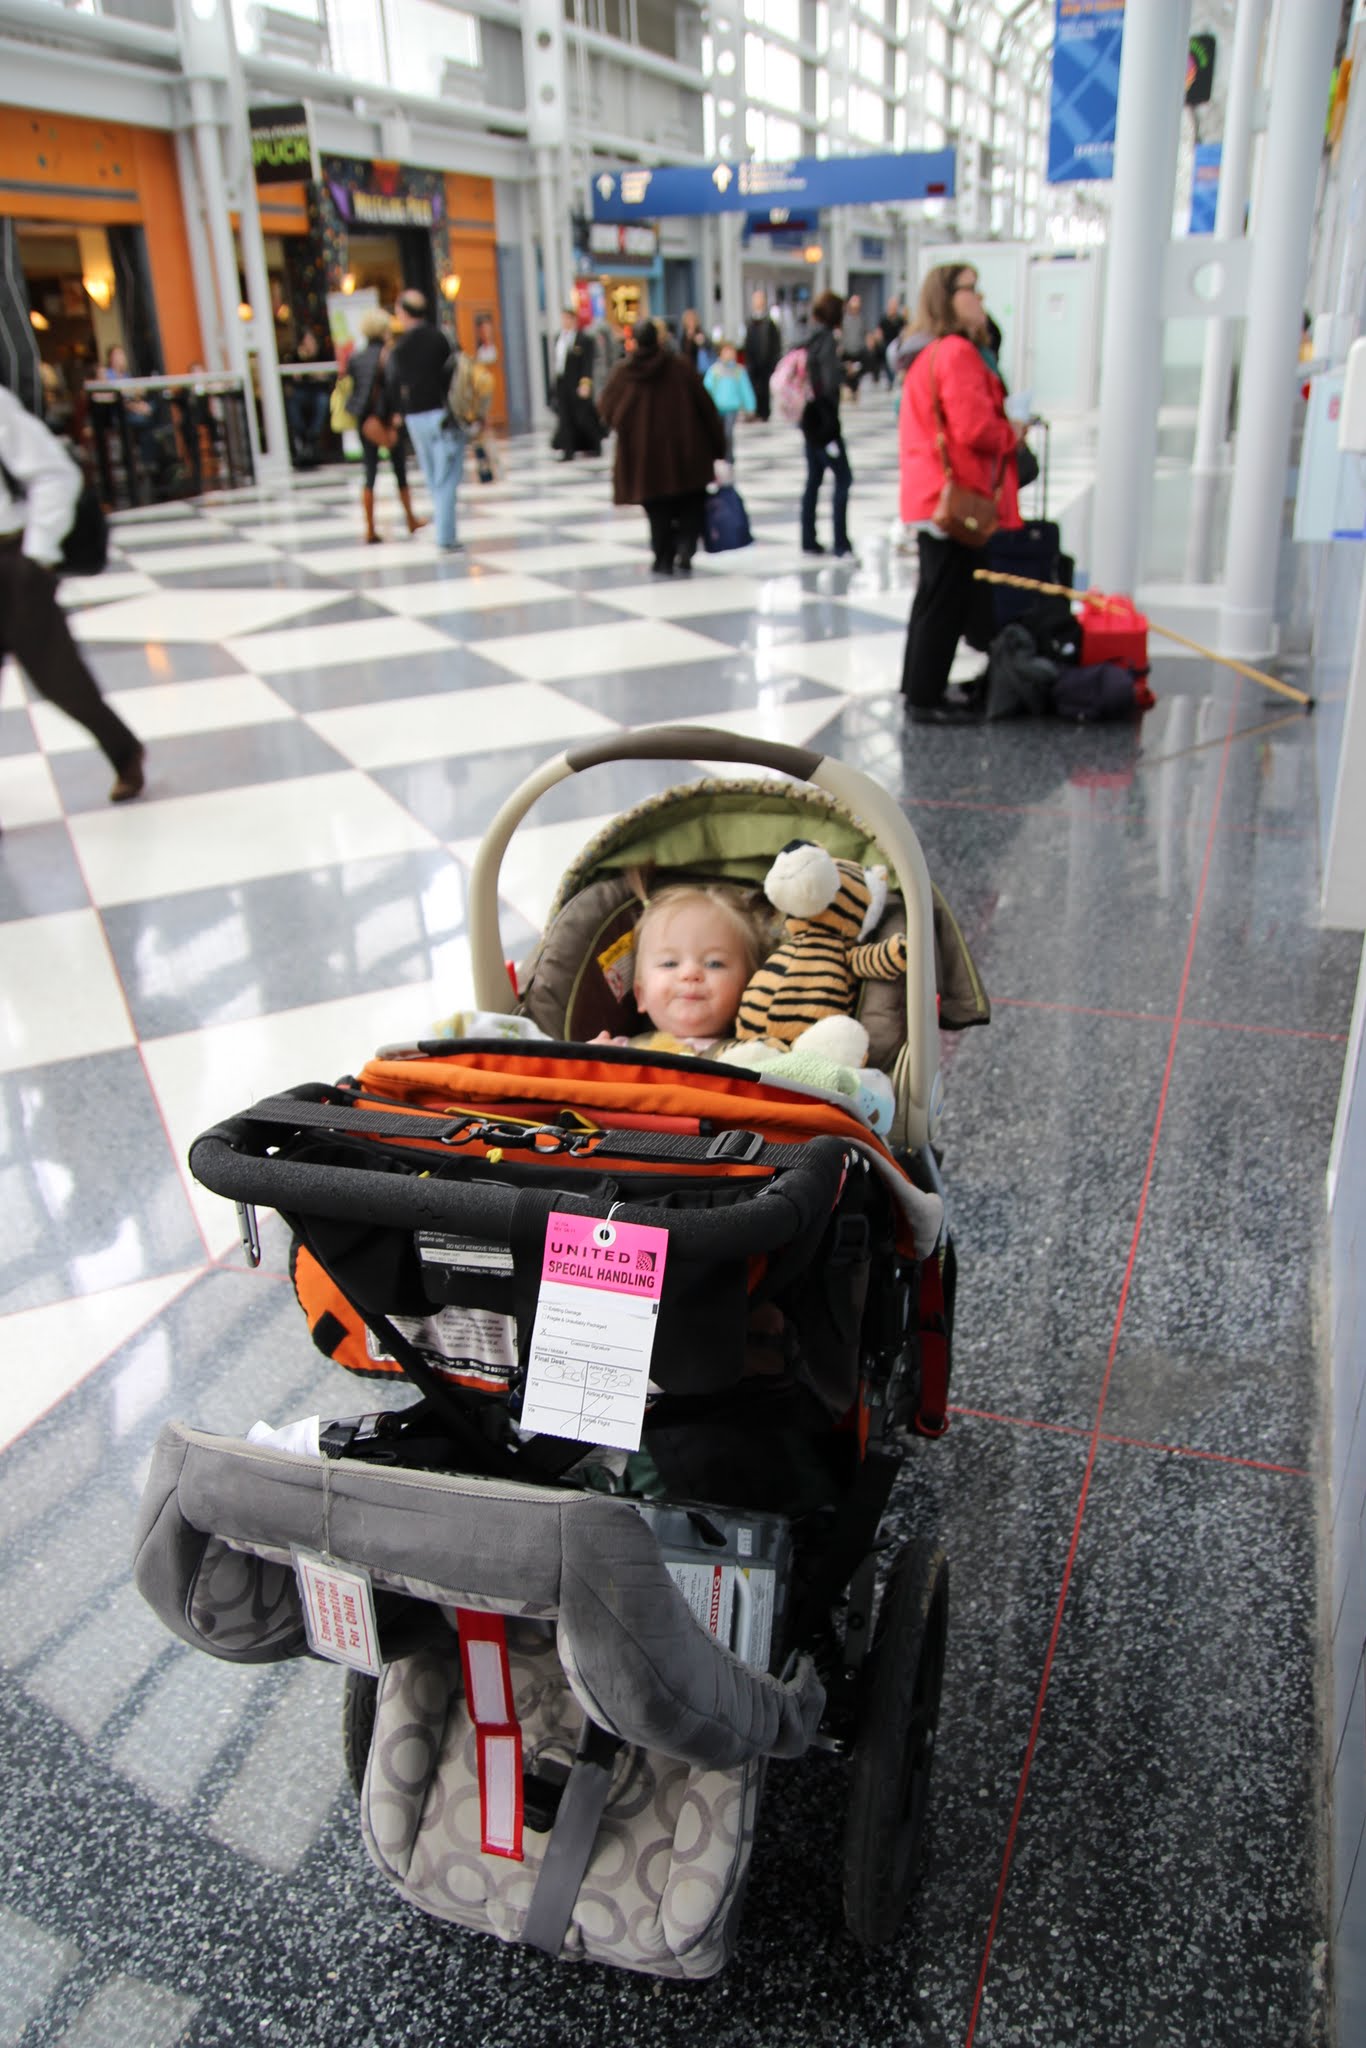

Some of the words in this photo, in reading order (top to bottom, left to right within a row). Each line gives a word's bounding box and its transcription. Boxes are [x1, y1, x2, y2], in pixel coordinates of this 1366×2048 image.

[551, 1242, 631, 1264] UNITED
[548, 1260, 594, 1279] SPECIAL
[597, 1267, 655, 1289] HANDLING
[564, 1307, 582, 1316] Damage
[534, 1355, 549, 1363] Final
[551, 1357, 566, 1365] Dest.
[591, 1343, 611, 1352] Signature
[314, 1577, 332, 1642] Emergency
[329, 1581, 347, 1650] Information
[343, 1594, 357, 1625] Child
[709, 1575, 720, 1635] RNING
[349, 1628, 360, 1648] For
